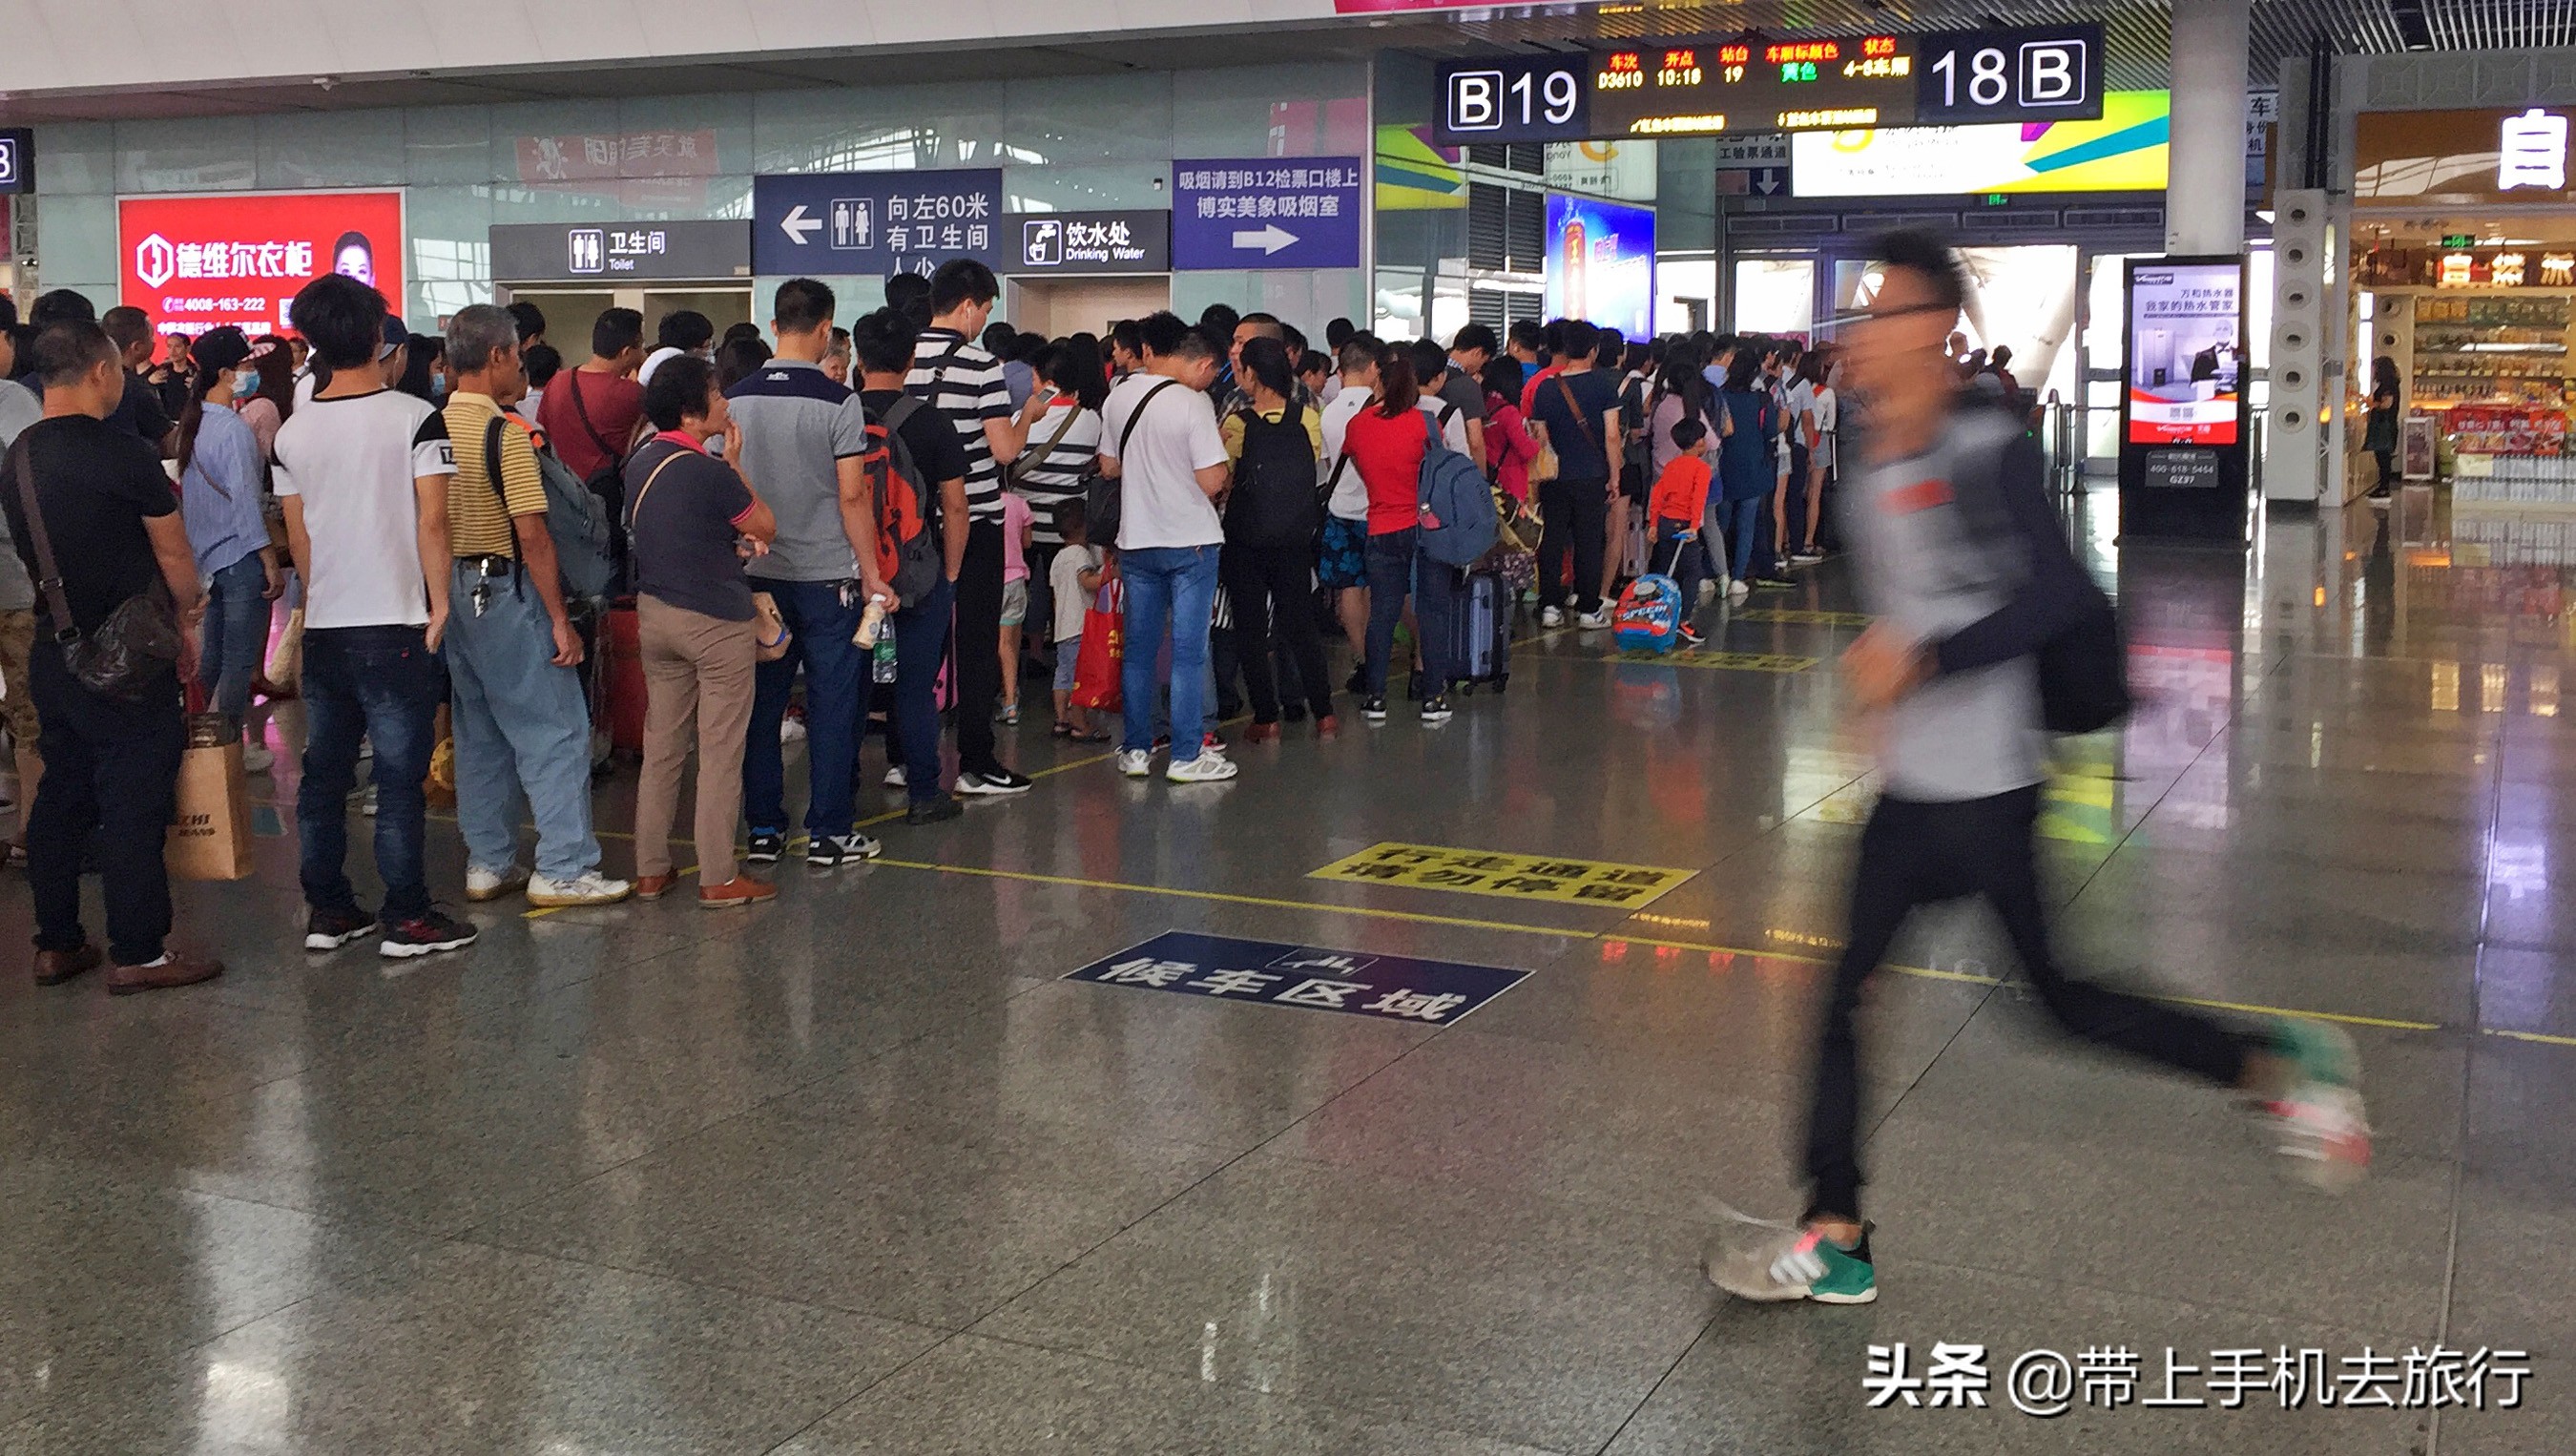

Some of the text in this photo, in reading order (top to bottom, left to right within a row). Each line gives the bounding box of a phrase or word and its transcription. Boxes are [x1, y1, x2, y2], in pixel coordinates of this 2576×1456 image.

[1610, 53, 1638, 71] 车次
[1720, 46, 1749, 63] 站台
[1864, 38, 1895, 55] 状态
[1598, 71, 1643, 89] D3610
[1657, 68, 1701, 87] 10:18
[1724, 66, 1744, 83] 19
[1781, 63, 1818, 83] 黄色
[1932, 48, 2072, 108] 18 B
[1459, 70, 1577, 125] B 19
[2499, 109, 2567, 190] 自
[1179, 167, 1359, 190] 吸烟请到B12检票口楼上
[887, 192, 989, 221] 向左60米
[1196, 195, 1339, 218] 博实美象吸烟室
[609, 230, 666, 256] 卫生间
[886, 223, 988, 252] 有卫生间
[1066, 221, 1131, 246] 饮水处
[176, 240, 313, 278] 德维尔衣柜
[609, 258, 634, 271] Toilet
[1066, 245, 1145, 262] Drinking Water
[887, 257, 936, 282] 人少
[184, 297, 265, 312] 4008-163-222
[1340, 862, 1646, 902] 请勿停留
[1096, 957, 1466, 1020] 候车区域
